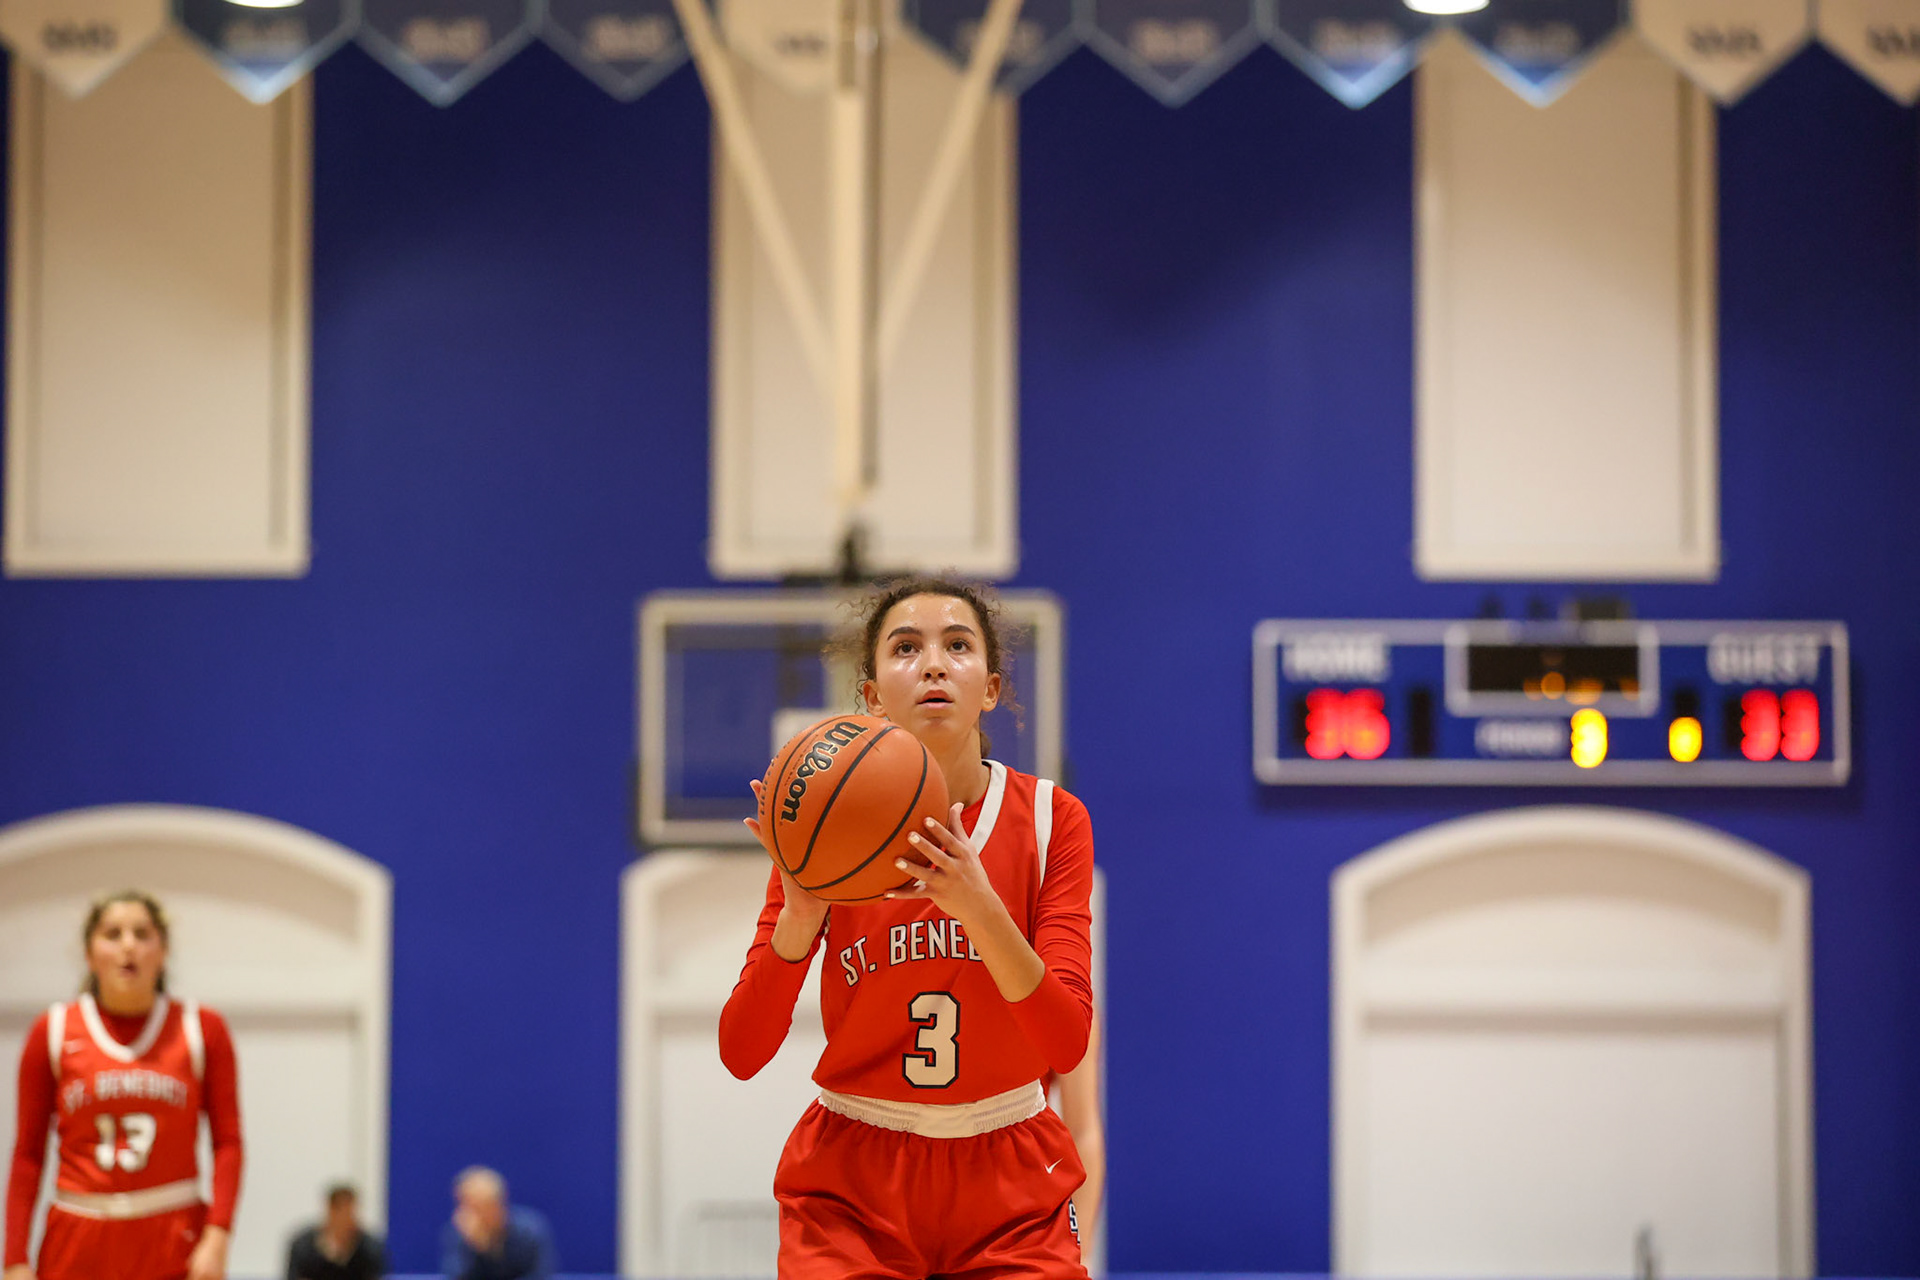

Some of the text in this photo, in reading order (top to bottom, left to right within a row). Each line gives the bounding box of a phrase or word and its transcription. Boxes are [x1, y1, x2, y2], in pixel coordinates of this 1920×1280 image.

[780, 721, 871, 824] Wilson
[839, 936, 878, 987] ST.
[902, 991, 961, 1089] 3
[94, 1112, 157, 1173] 13
